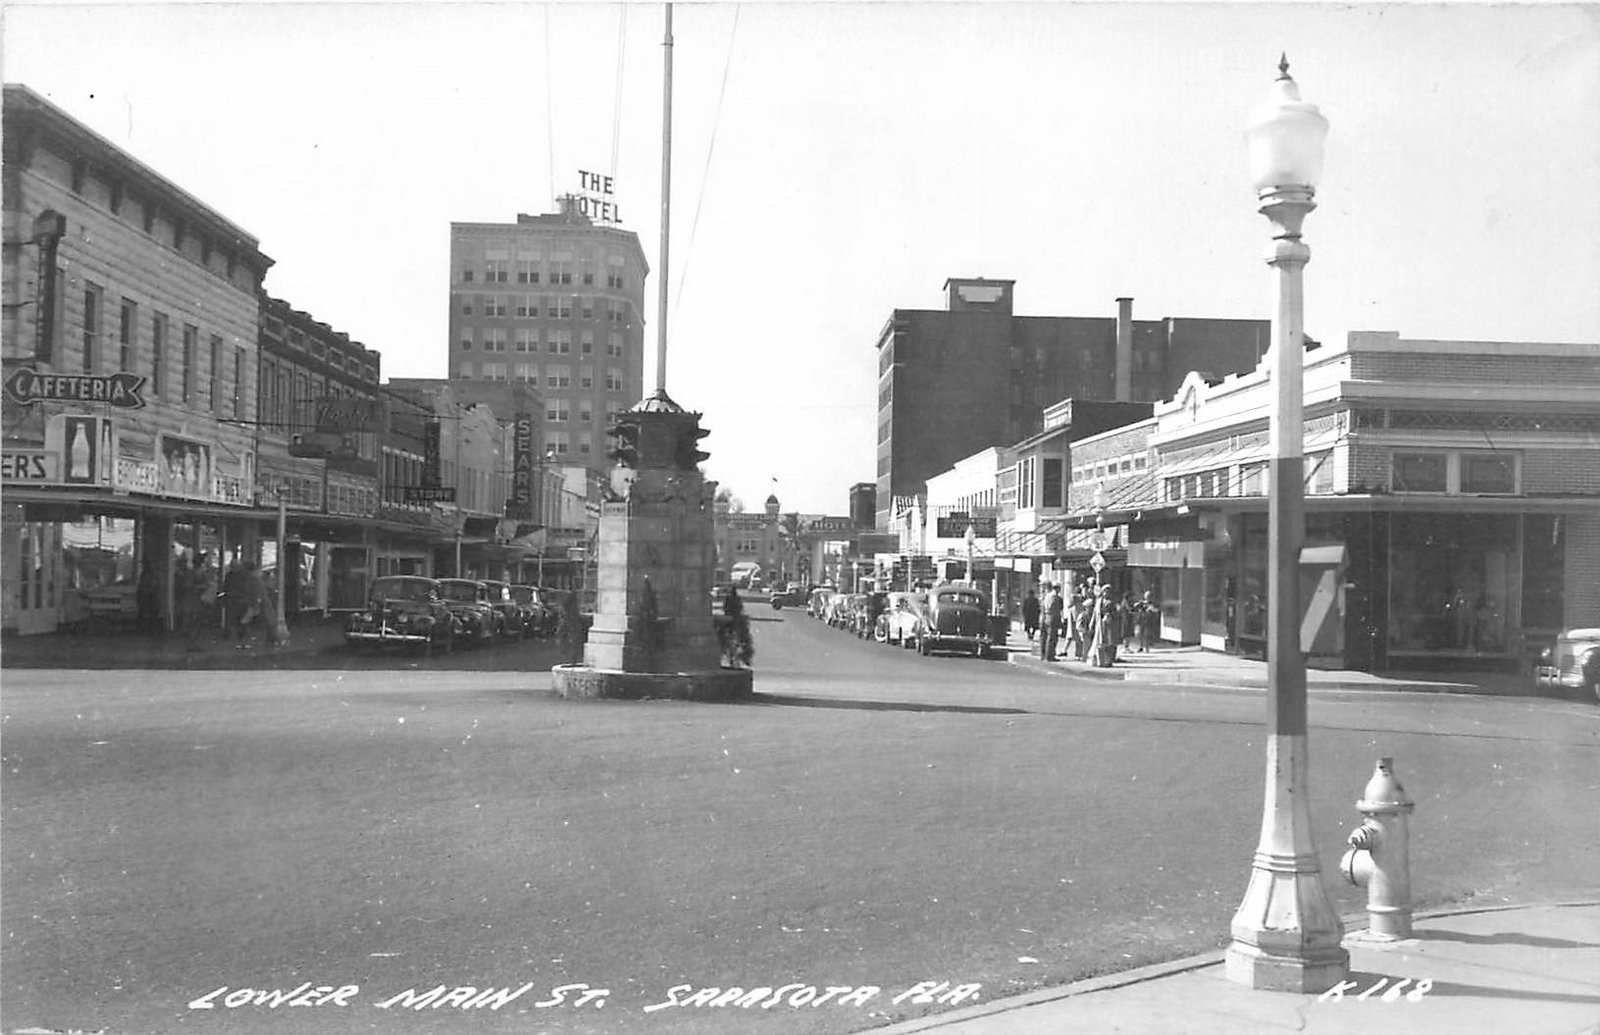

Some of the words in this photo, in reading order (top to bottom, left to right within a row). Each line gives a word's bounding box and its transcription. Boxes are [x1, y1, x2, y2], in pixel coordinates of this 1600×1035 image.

[578, 170, 613, 195] THE
[15, 376, 125, 399] CAFETERIA
[517, 419, 530, 504] SEARS
